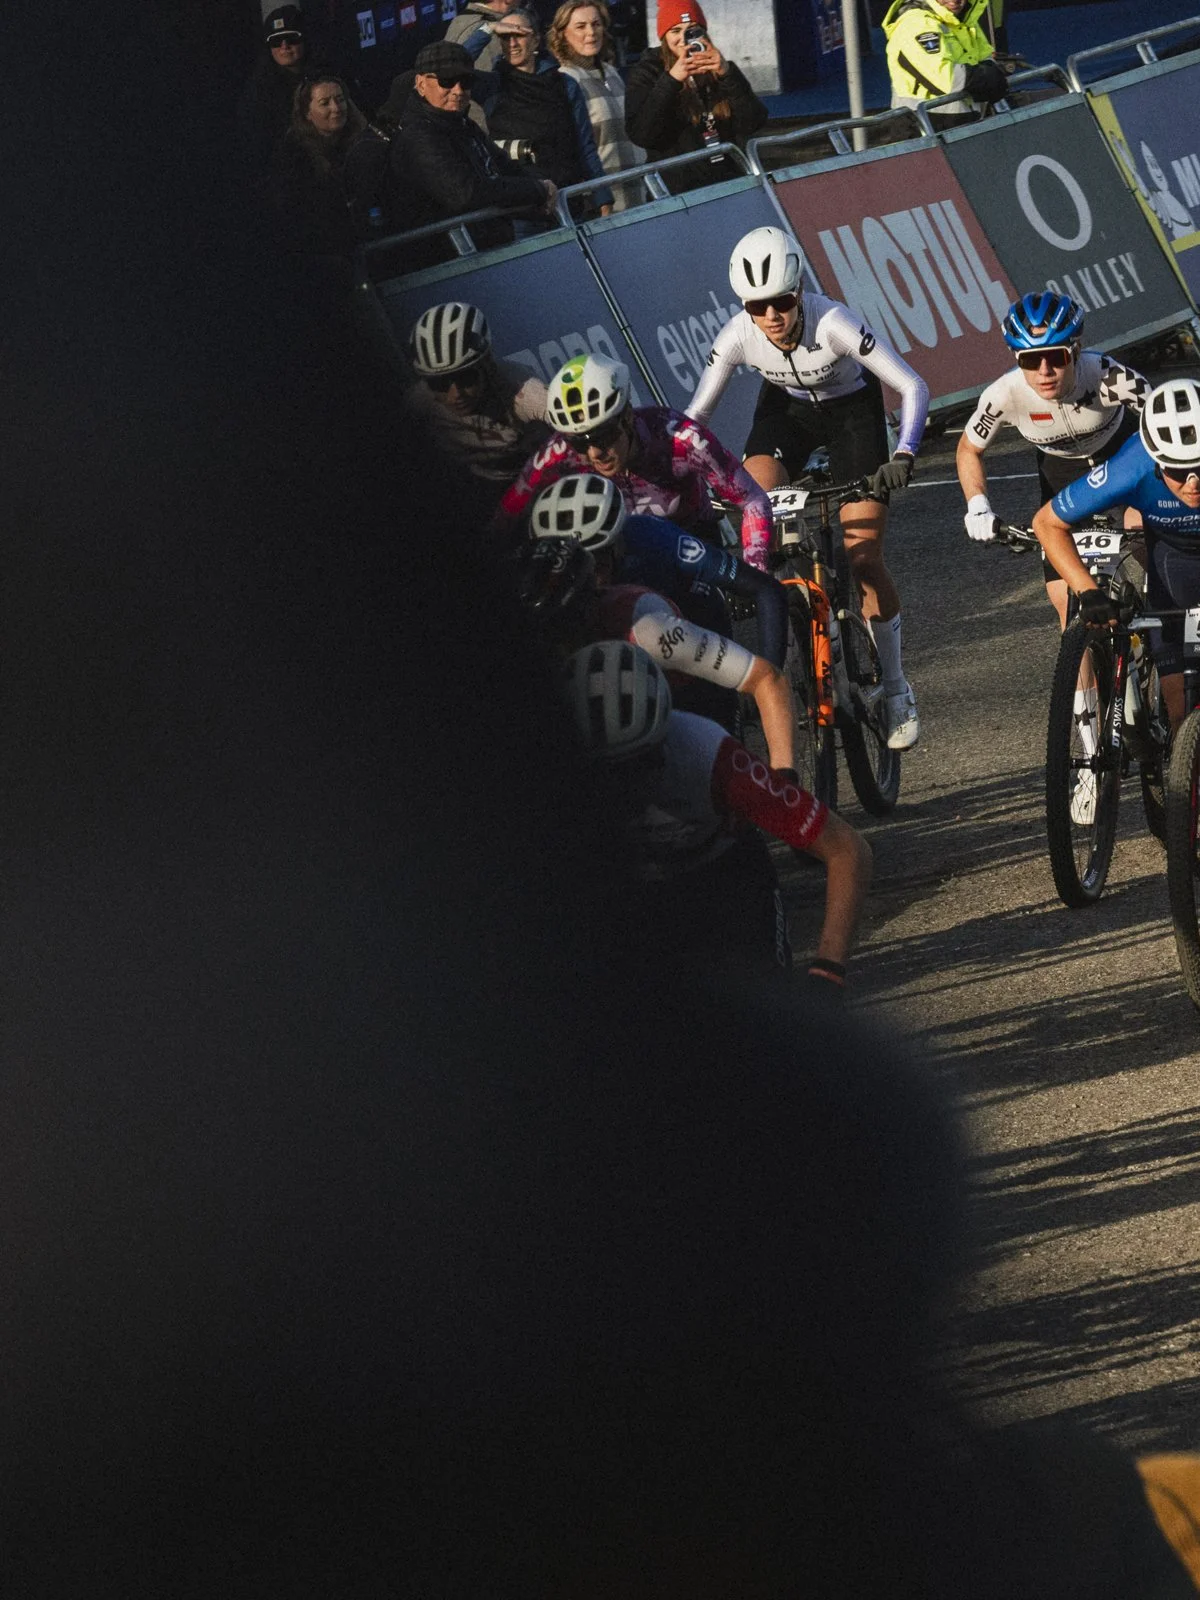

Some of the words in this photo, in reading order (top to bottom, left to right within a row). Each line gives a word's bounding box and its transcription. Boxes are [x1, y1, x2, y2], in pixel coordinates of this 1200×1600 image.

[818, 199, 1010, 353] MOTUL
[973, 402, 1004, 440] BMC
[769, 493, 798, 506] 44
[1076, 535, 1112, 549] 46
[1112, 696, 1124, 729] SWISS
